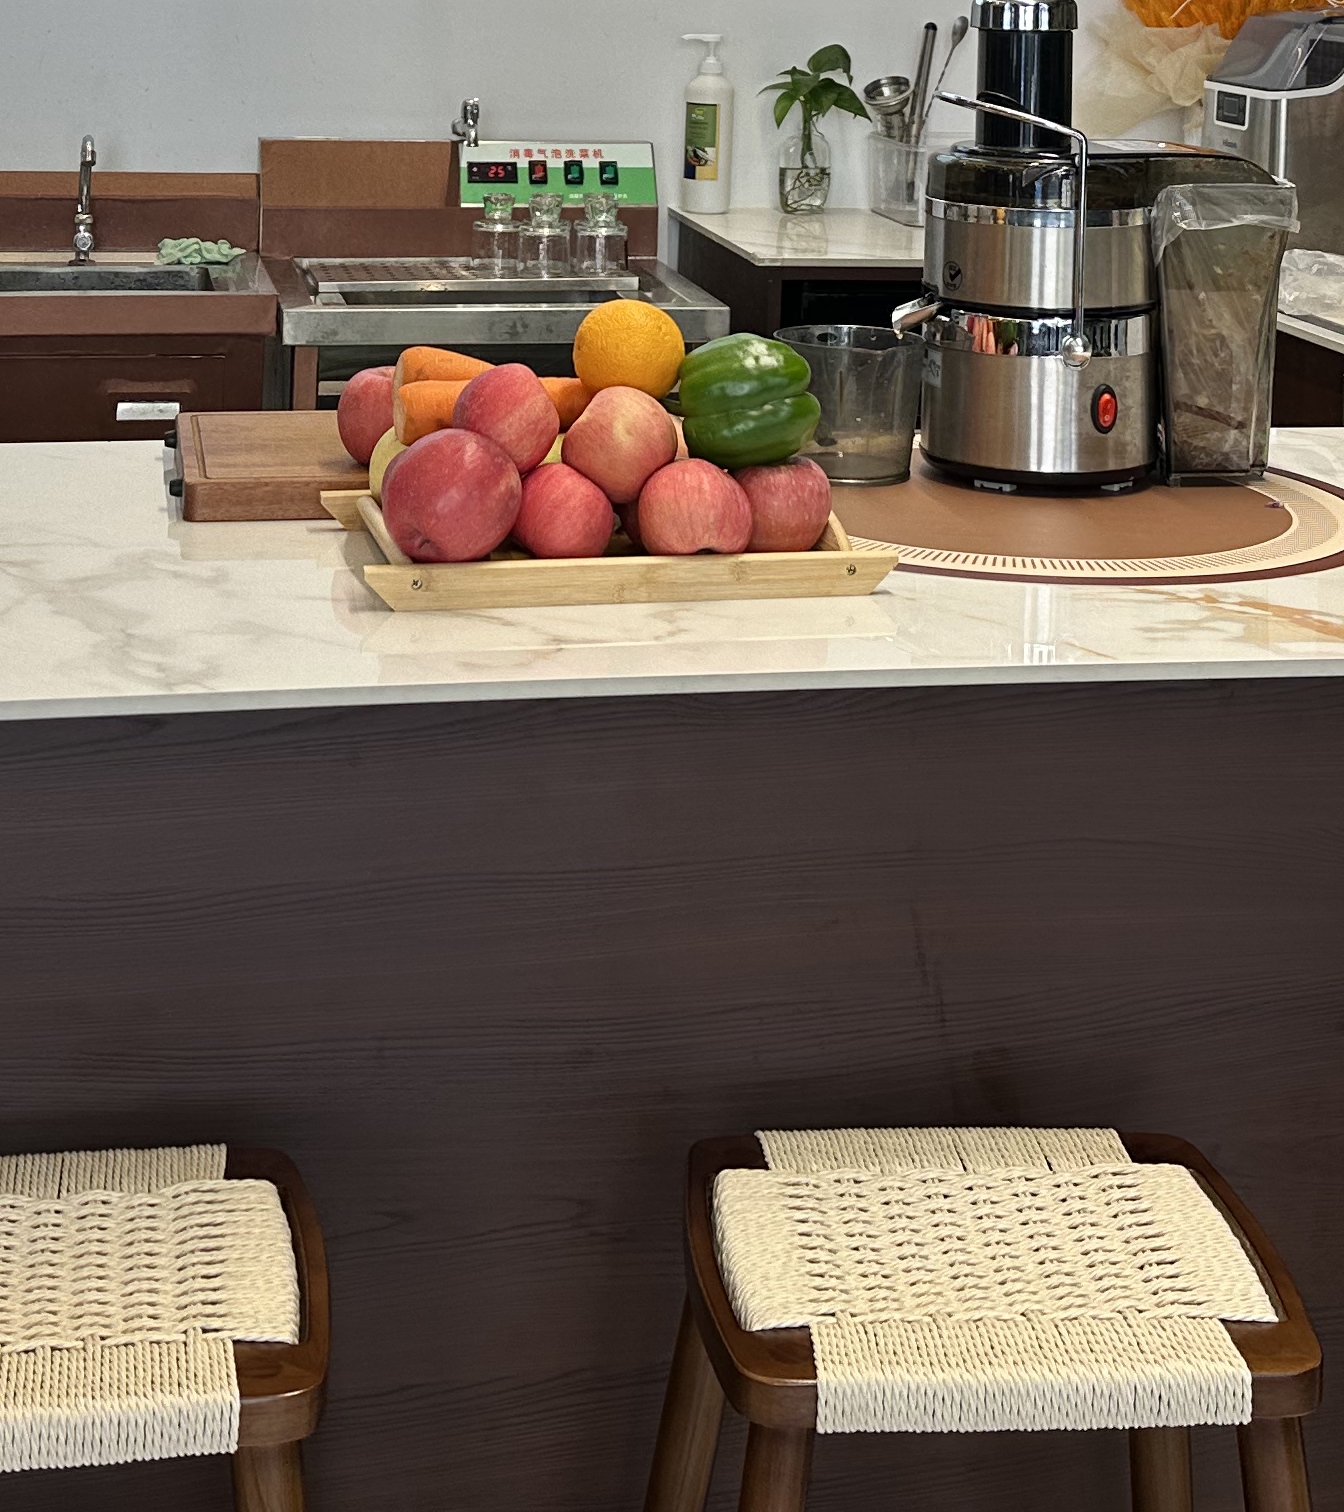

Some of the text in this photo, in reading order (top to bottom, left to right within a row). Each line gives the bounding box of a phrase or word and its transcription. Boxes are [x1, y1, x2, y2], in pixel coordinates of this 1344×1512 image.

[509, 149, 604, 159] 消毒气泡洗菜机
[488, 166, 505, 178] 25
